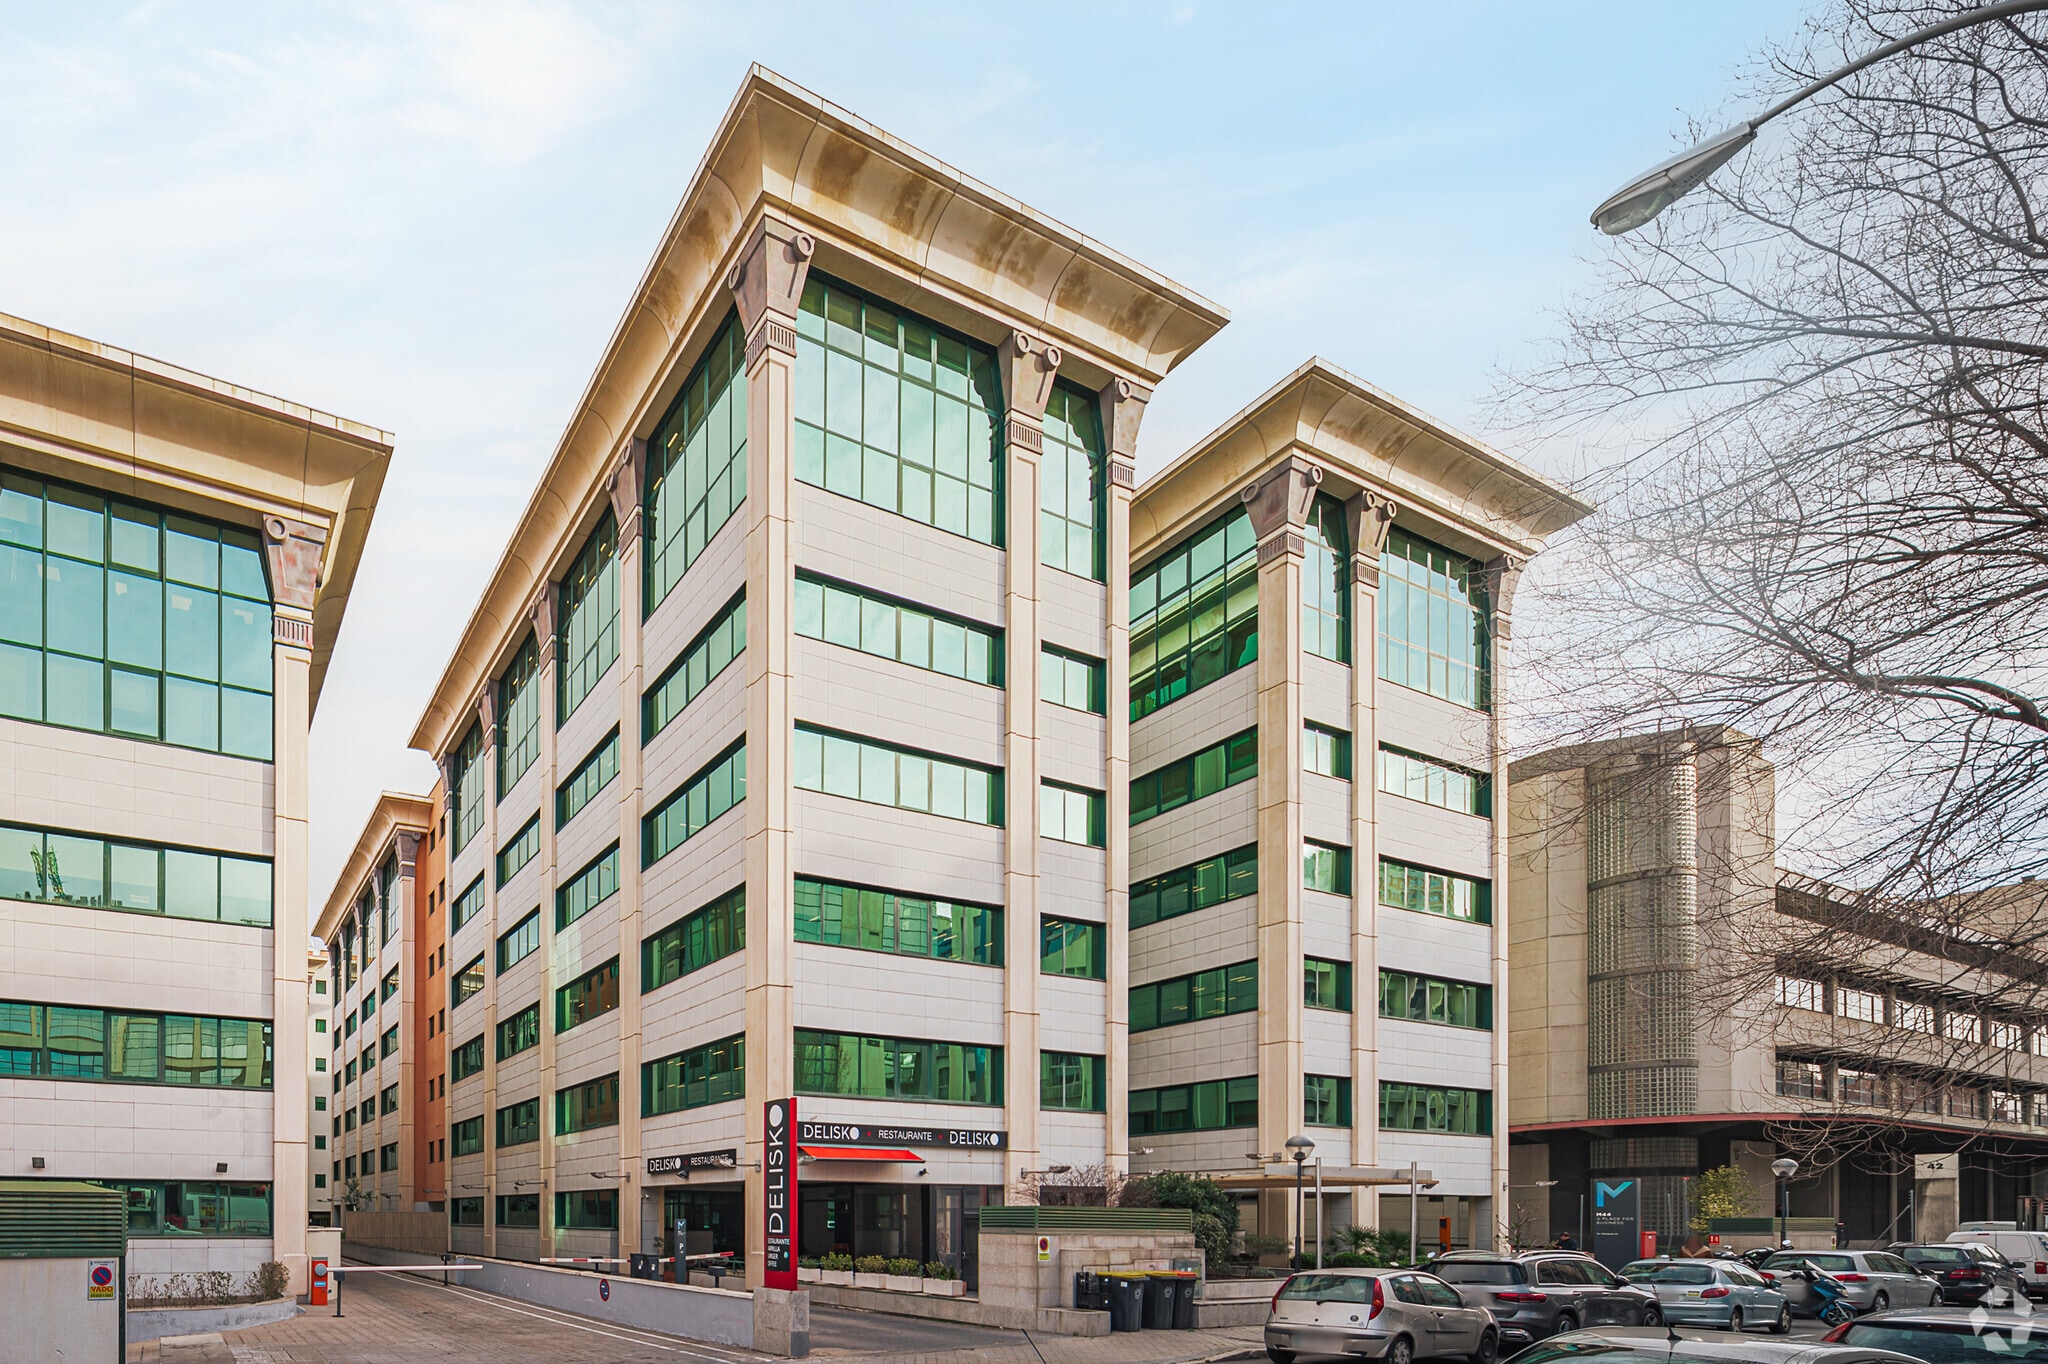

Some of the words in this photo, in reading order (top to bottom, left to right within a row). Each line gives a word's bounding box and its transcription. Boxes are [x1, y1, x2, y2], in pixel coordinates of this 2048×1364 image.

[803, 1124, 860, 1140] DELISKO
[878, 1129, 932, 1141] RESTAURANTE
[949, 1130, 1000, 1146] DELISKO
[649, 1157, 681, 1172] DELISKO
[769, 1104, 784, 1234] DELISKO
